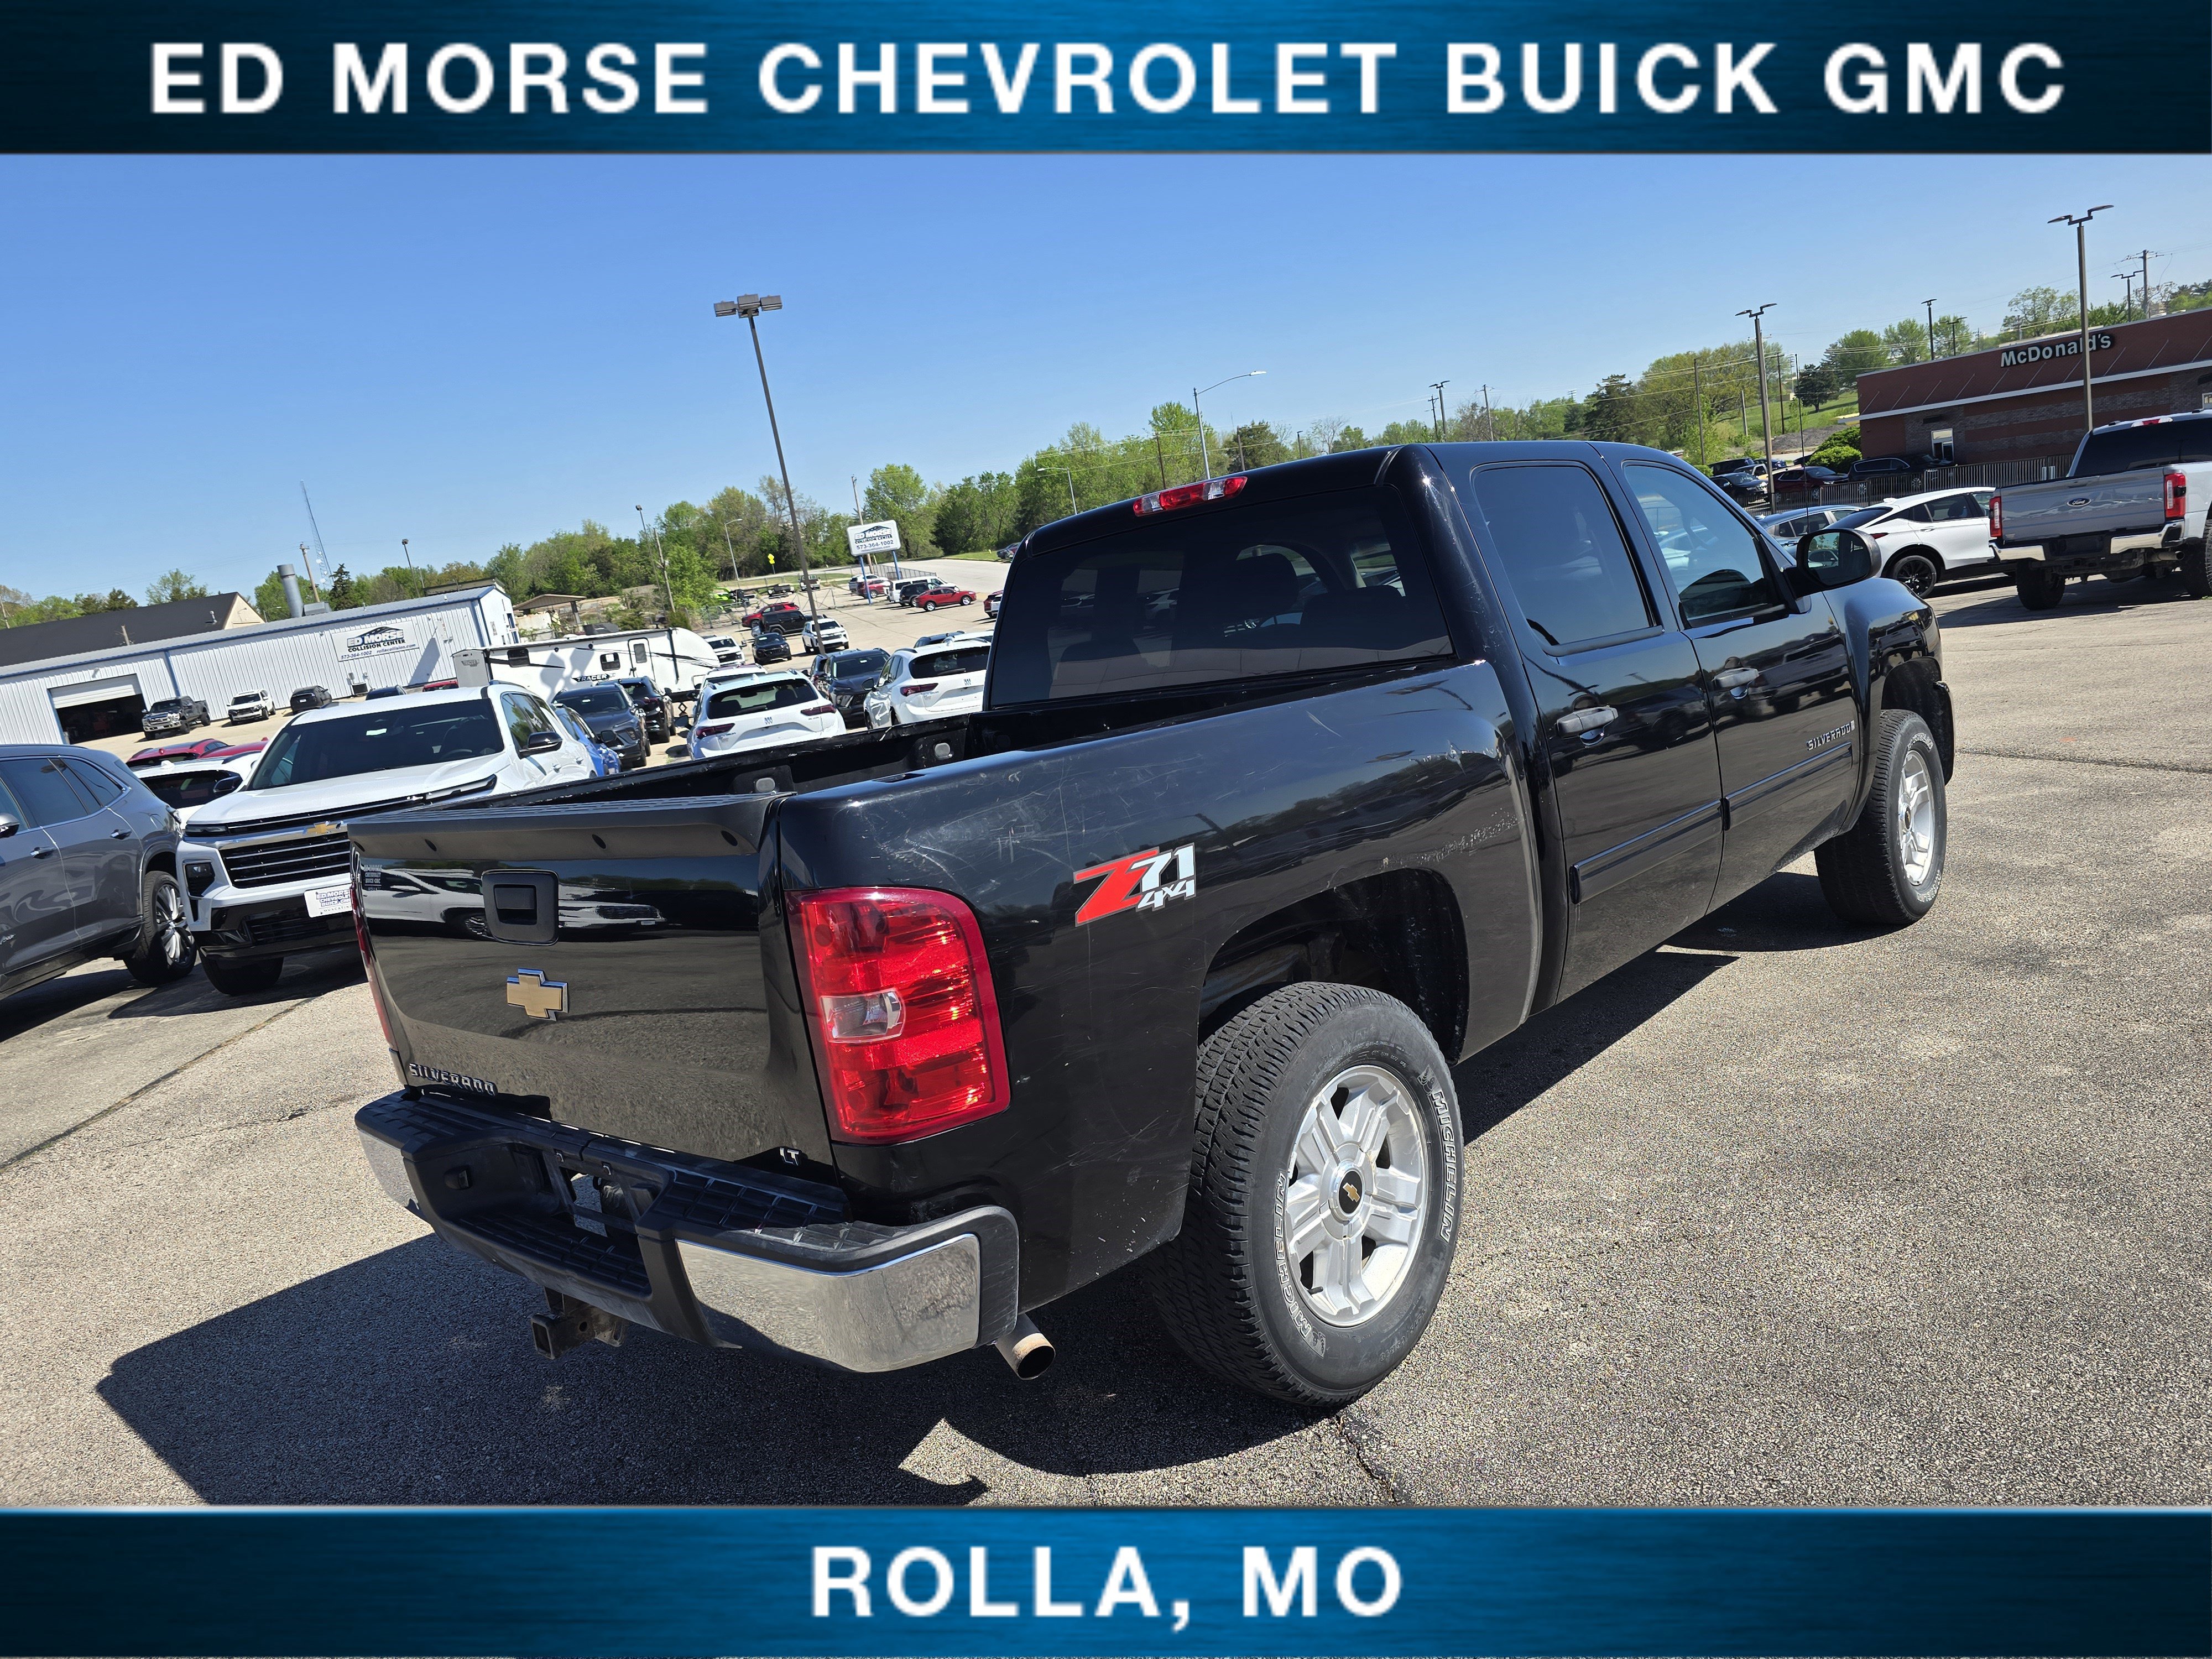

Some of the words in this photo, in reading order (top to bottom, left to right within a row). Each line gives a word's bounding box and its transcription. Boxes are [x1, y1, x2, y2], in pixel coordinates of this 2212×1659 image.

[2000, 333, 2111, 367] McDonald's
[865, 528, 891, 538] MORSE
[856, 540, 894, 550] 573-364-1002
[347, 637, 363, 648] ED
[363, 629, 404, 644] MORSE
[348, 643, 382, 653] COLLISION
[383, 639, 406, 647] CENTER
[341, 650, 372, 660] 573-364-1002
[377, 644, 416, 654] rollacollision.com
[576, 674, 607, 682] TRACER
[1806, 722, 1851, 751] SILVERADO
[327, 889, 350, 898] MORS
[1074, 844, 1194, 926] Z71
[409, 1062, 496, 1097] SILVERADO
[779, 1147, 800, 1166] LT
[1431, 1089, 1457, 1244] MICHELIN
[1274, 1171, 1313, 1339] MICHELIN
